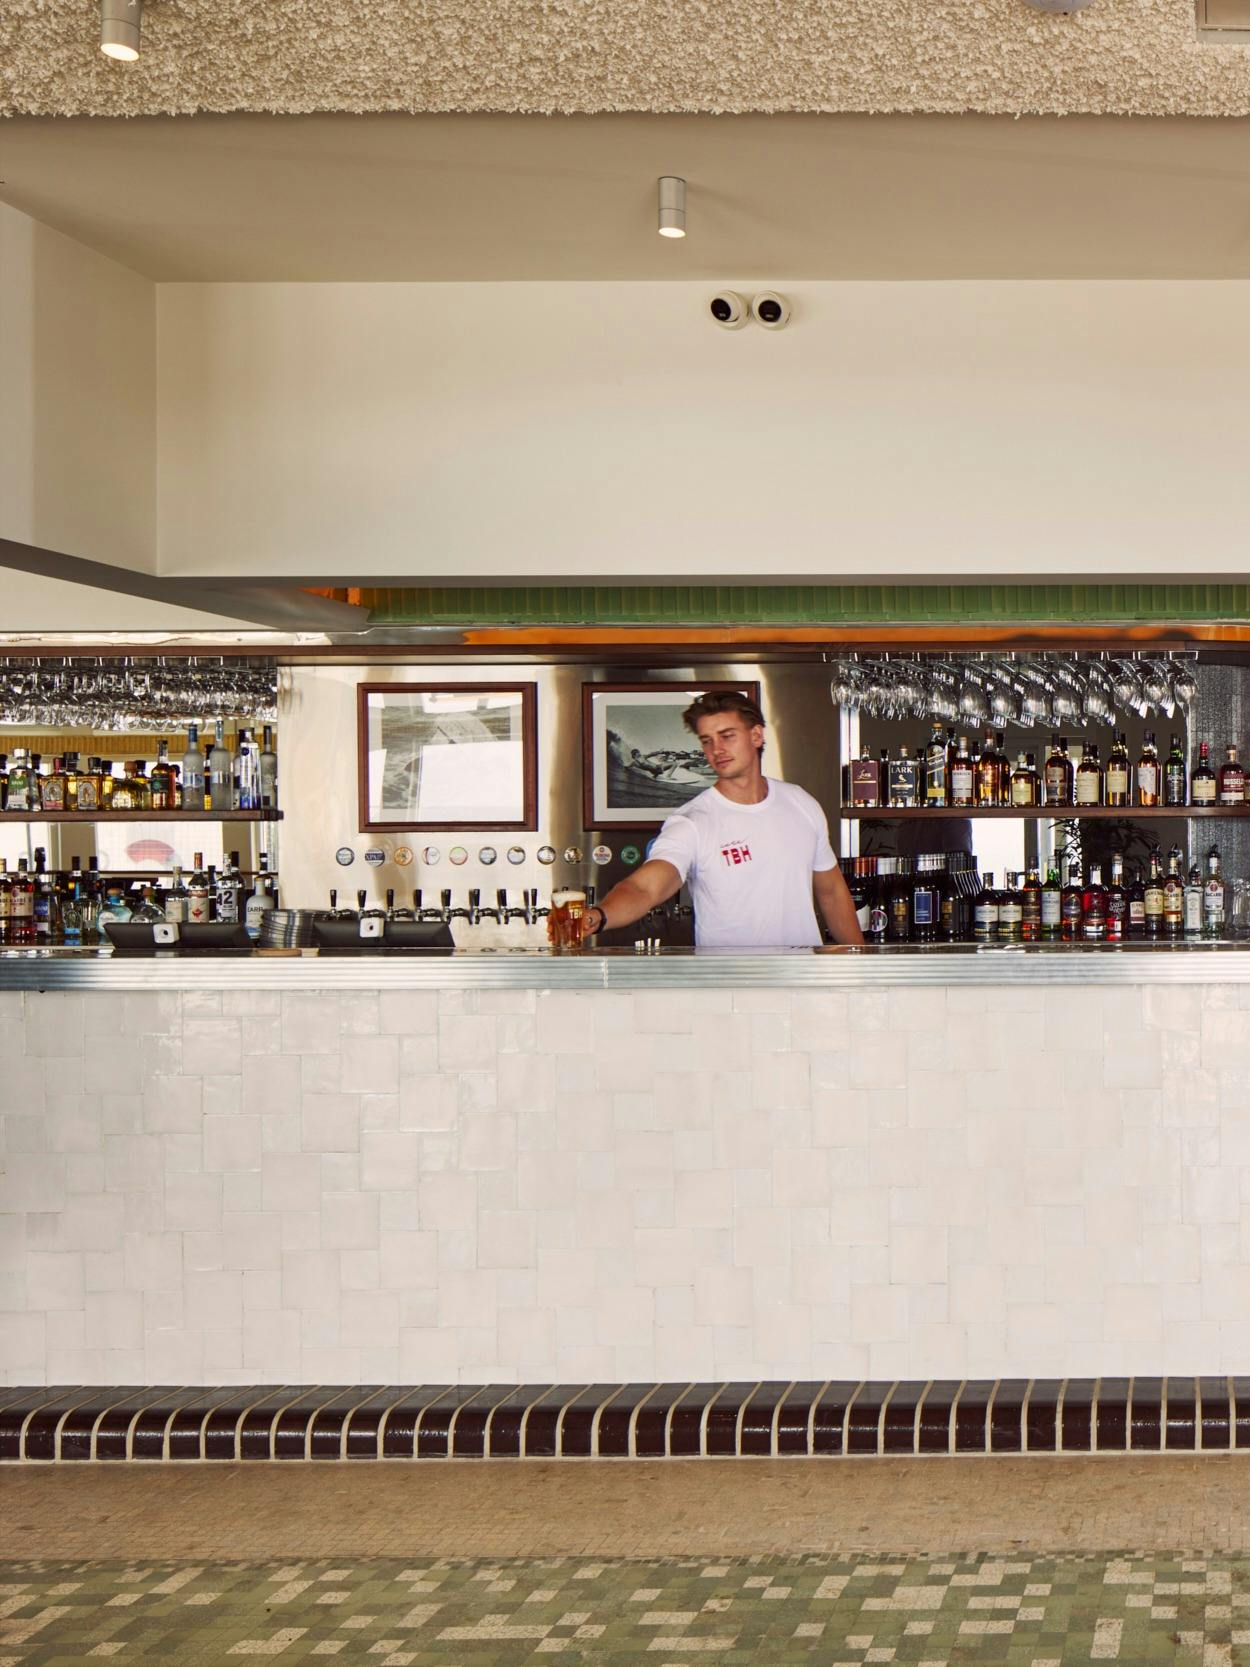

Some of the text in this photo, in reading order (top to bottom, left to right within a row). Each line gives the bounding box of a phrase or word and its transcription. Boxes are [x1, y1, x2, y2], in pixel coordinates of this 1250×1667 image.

[891, 766, 913, 774] LARK
[722, 844, 752, 867] TBH
[216, 890, 233, 906] 42
